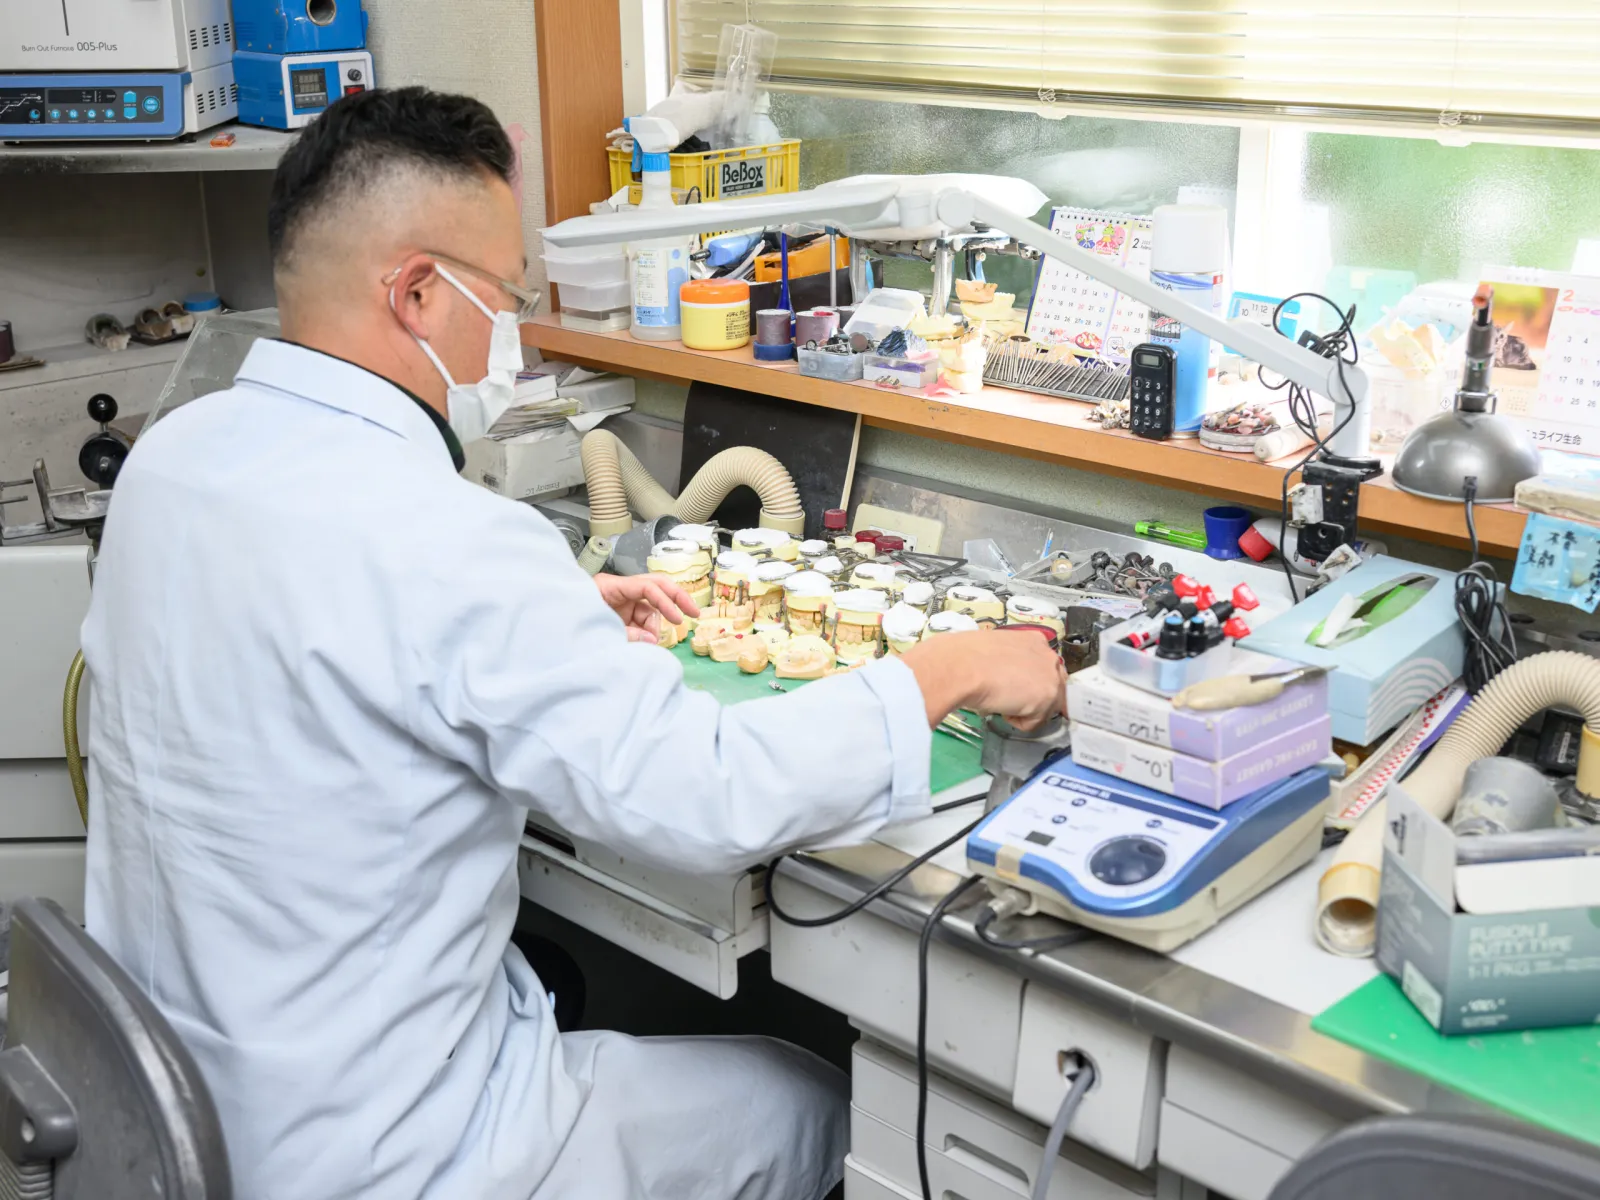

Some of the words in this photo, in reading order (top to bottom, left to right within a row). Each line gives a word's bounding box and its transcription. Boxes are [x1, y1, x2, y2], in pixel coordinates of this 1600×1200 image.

[76, 42, 118, 51] 005-Plus
[722, 162, 763, 184] BeBox
[1132, 238, 1139, 248] 2
[1563, 290, 1574, 302] 2
